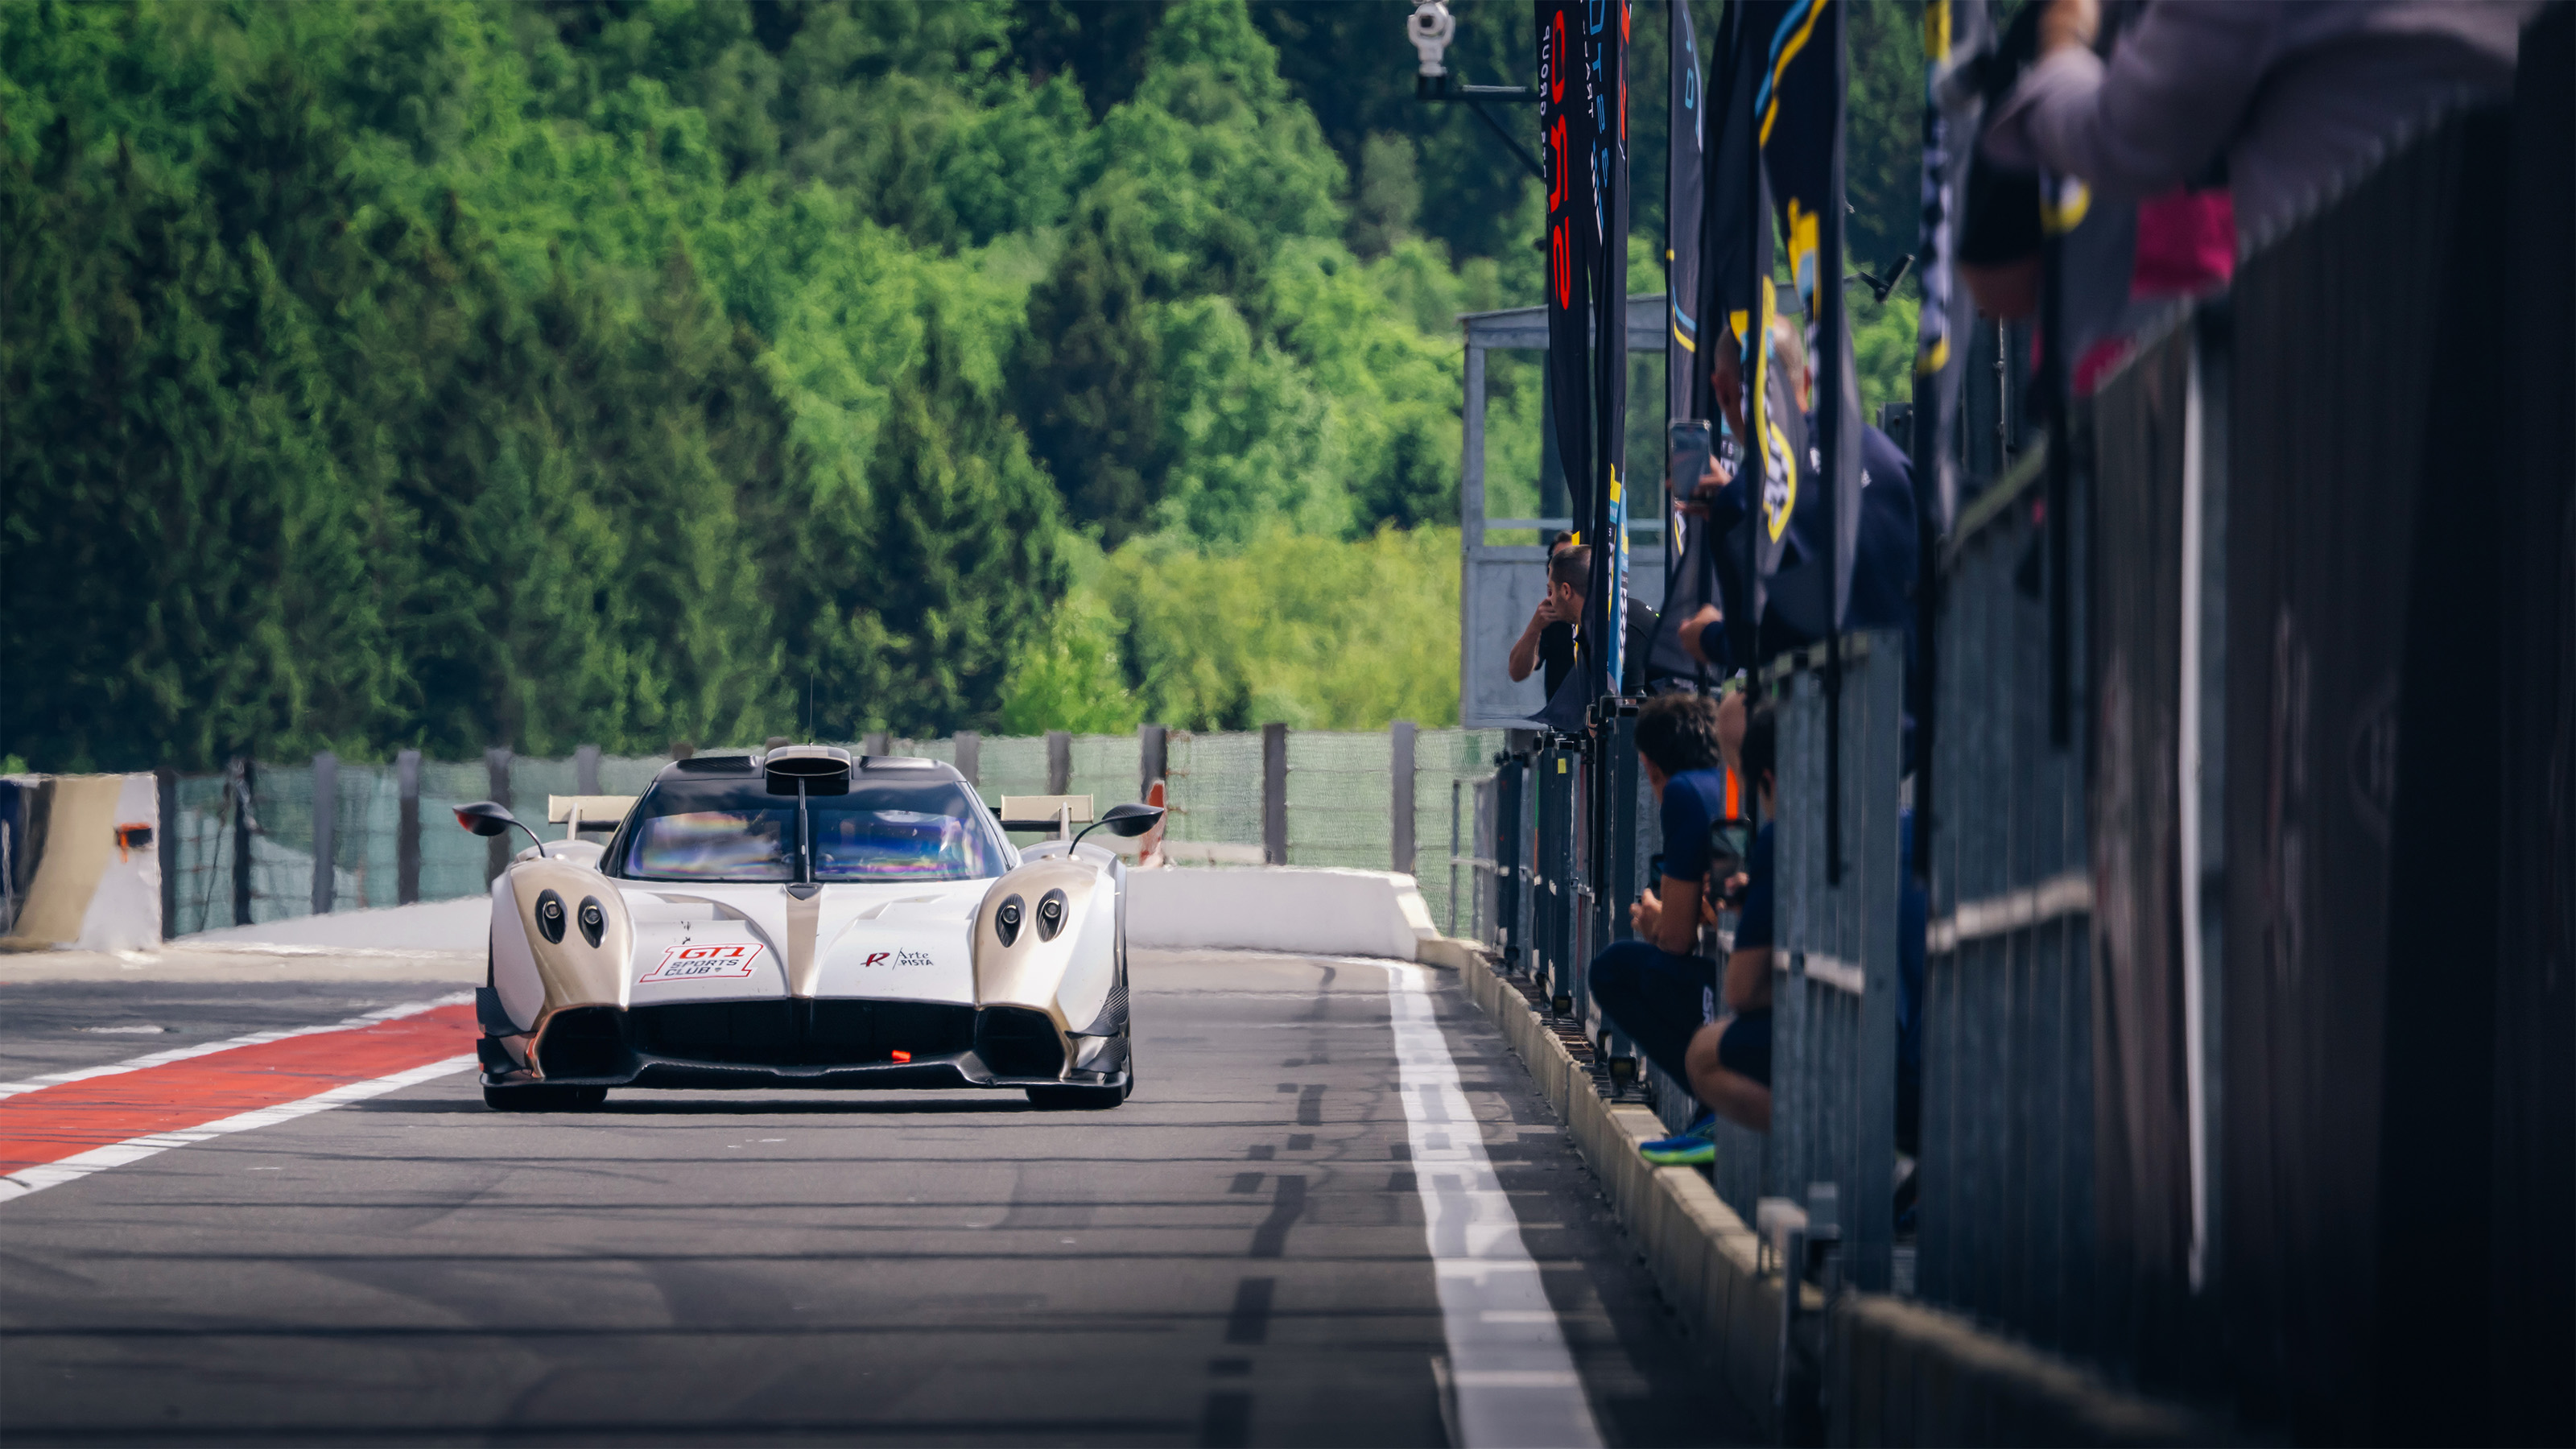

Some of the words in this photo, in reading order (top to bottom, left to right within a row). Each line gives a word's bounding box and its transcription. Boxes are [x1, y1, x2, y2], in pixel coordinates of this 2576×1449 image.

[679, 946, 745, 959] GT1
[896, 947, 929, 960] Arte
[670, 959, 739, 969] SPORTS
[664, 966, 711, 976] CLUB
